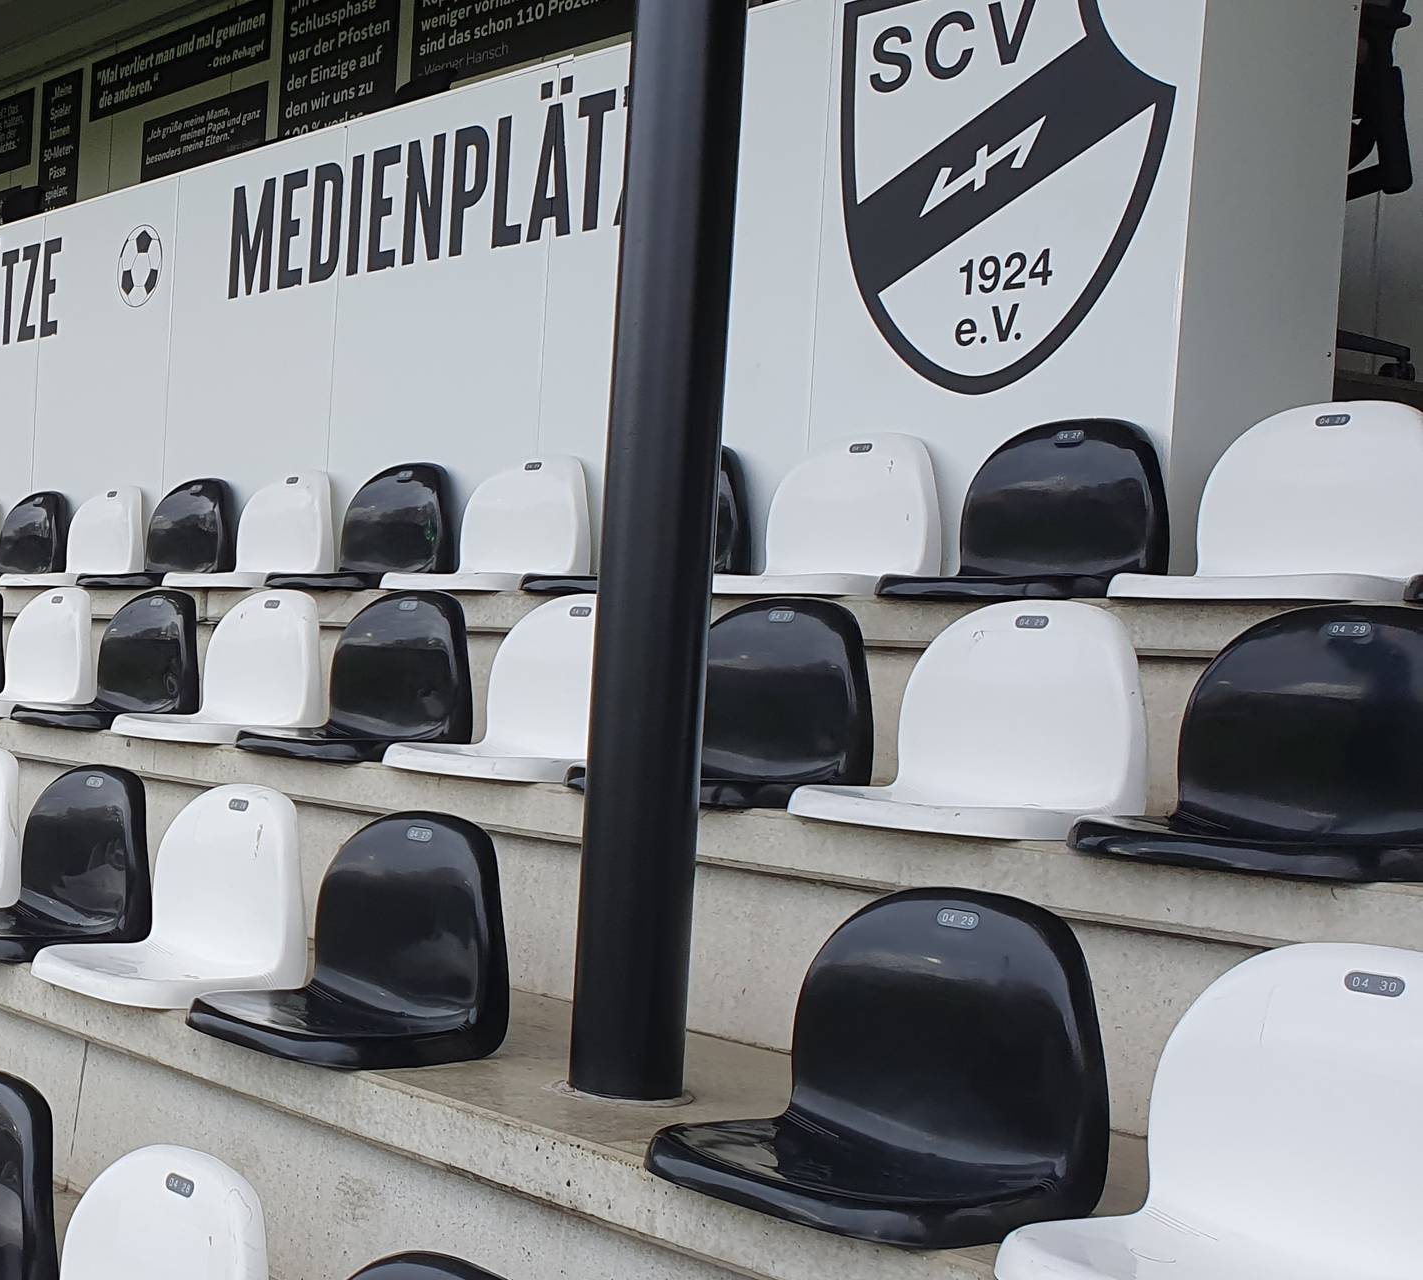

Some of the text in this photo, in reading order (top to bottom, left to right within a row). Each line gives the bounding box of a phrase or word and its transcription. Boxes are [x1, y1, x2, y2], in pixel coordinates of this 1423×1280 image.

[290, 0, 376, 37] Schlussphase
[419, 34, 445, 56] sind
[448, 28, 471, 47] das
[474, 15, 513, 39] schon
[516, 3, 544, 26] 110
[421, 9, 471, 31] weniger
[119, 52, 154, 77] verliert
[155, 47, 175, 66] man
[177, 35, 195, 58] und
[196, 27, 215, 50] mal
[216, 13, 266, 48] gewinnen
[289, 19, 390, 64] war der Pfosten
[869, 0, 1038, 93] SCV
[287, 44, 383, 92] der Einzige auf
[99, 91, 112, 109] die
[285, 101, 308, 119] den
[311, 91, 330, 111] wir
[333, 86, 355, 104] uns
[358, 81, 374, 97] zu
[184, 113, 205, 129] meine
[145, 147, 181, 166] besonders
[182, 140, 204, 154] meine
[228, 75, 629, 300] MEDIENPLÄT
[959, 248, 1053, 296] 1924
[955, 303, 1022, 346] e.V.
[1332, 624, 1366, 634] 04 29
[942, 912, 974, 926] 04 29
[1352, 976, 1397, 993] 04 30
[169, 1178, 178, 1188] 04
